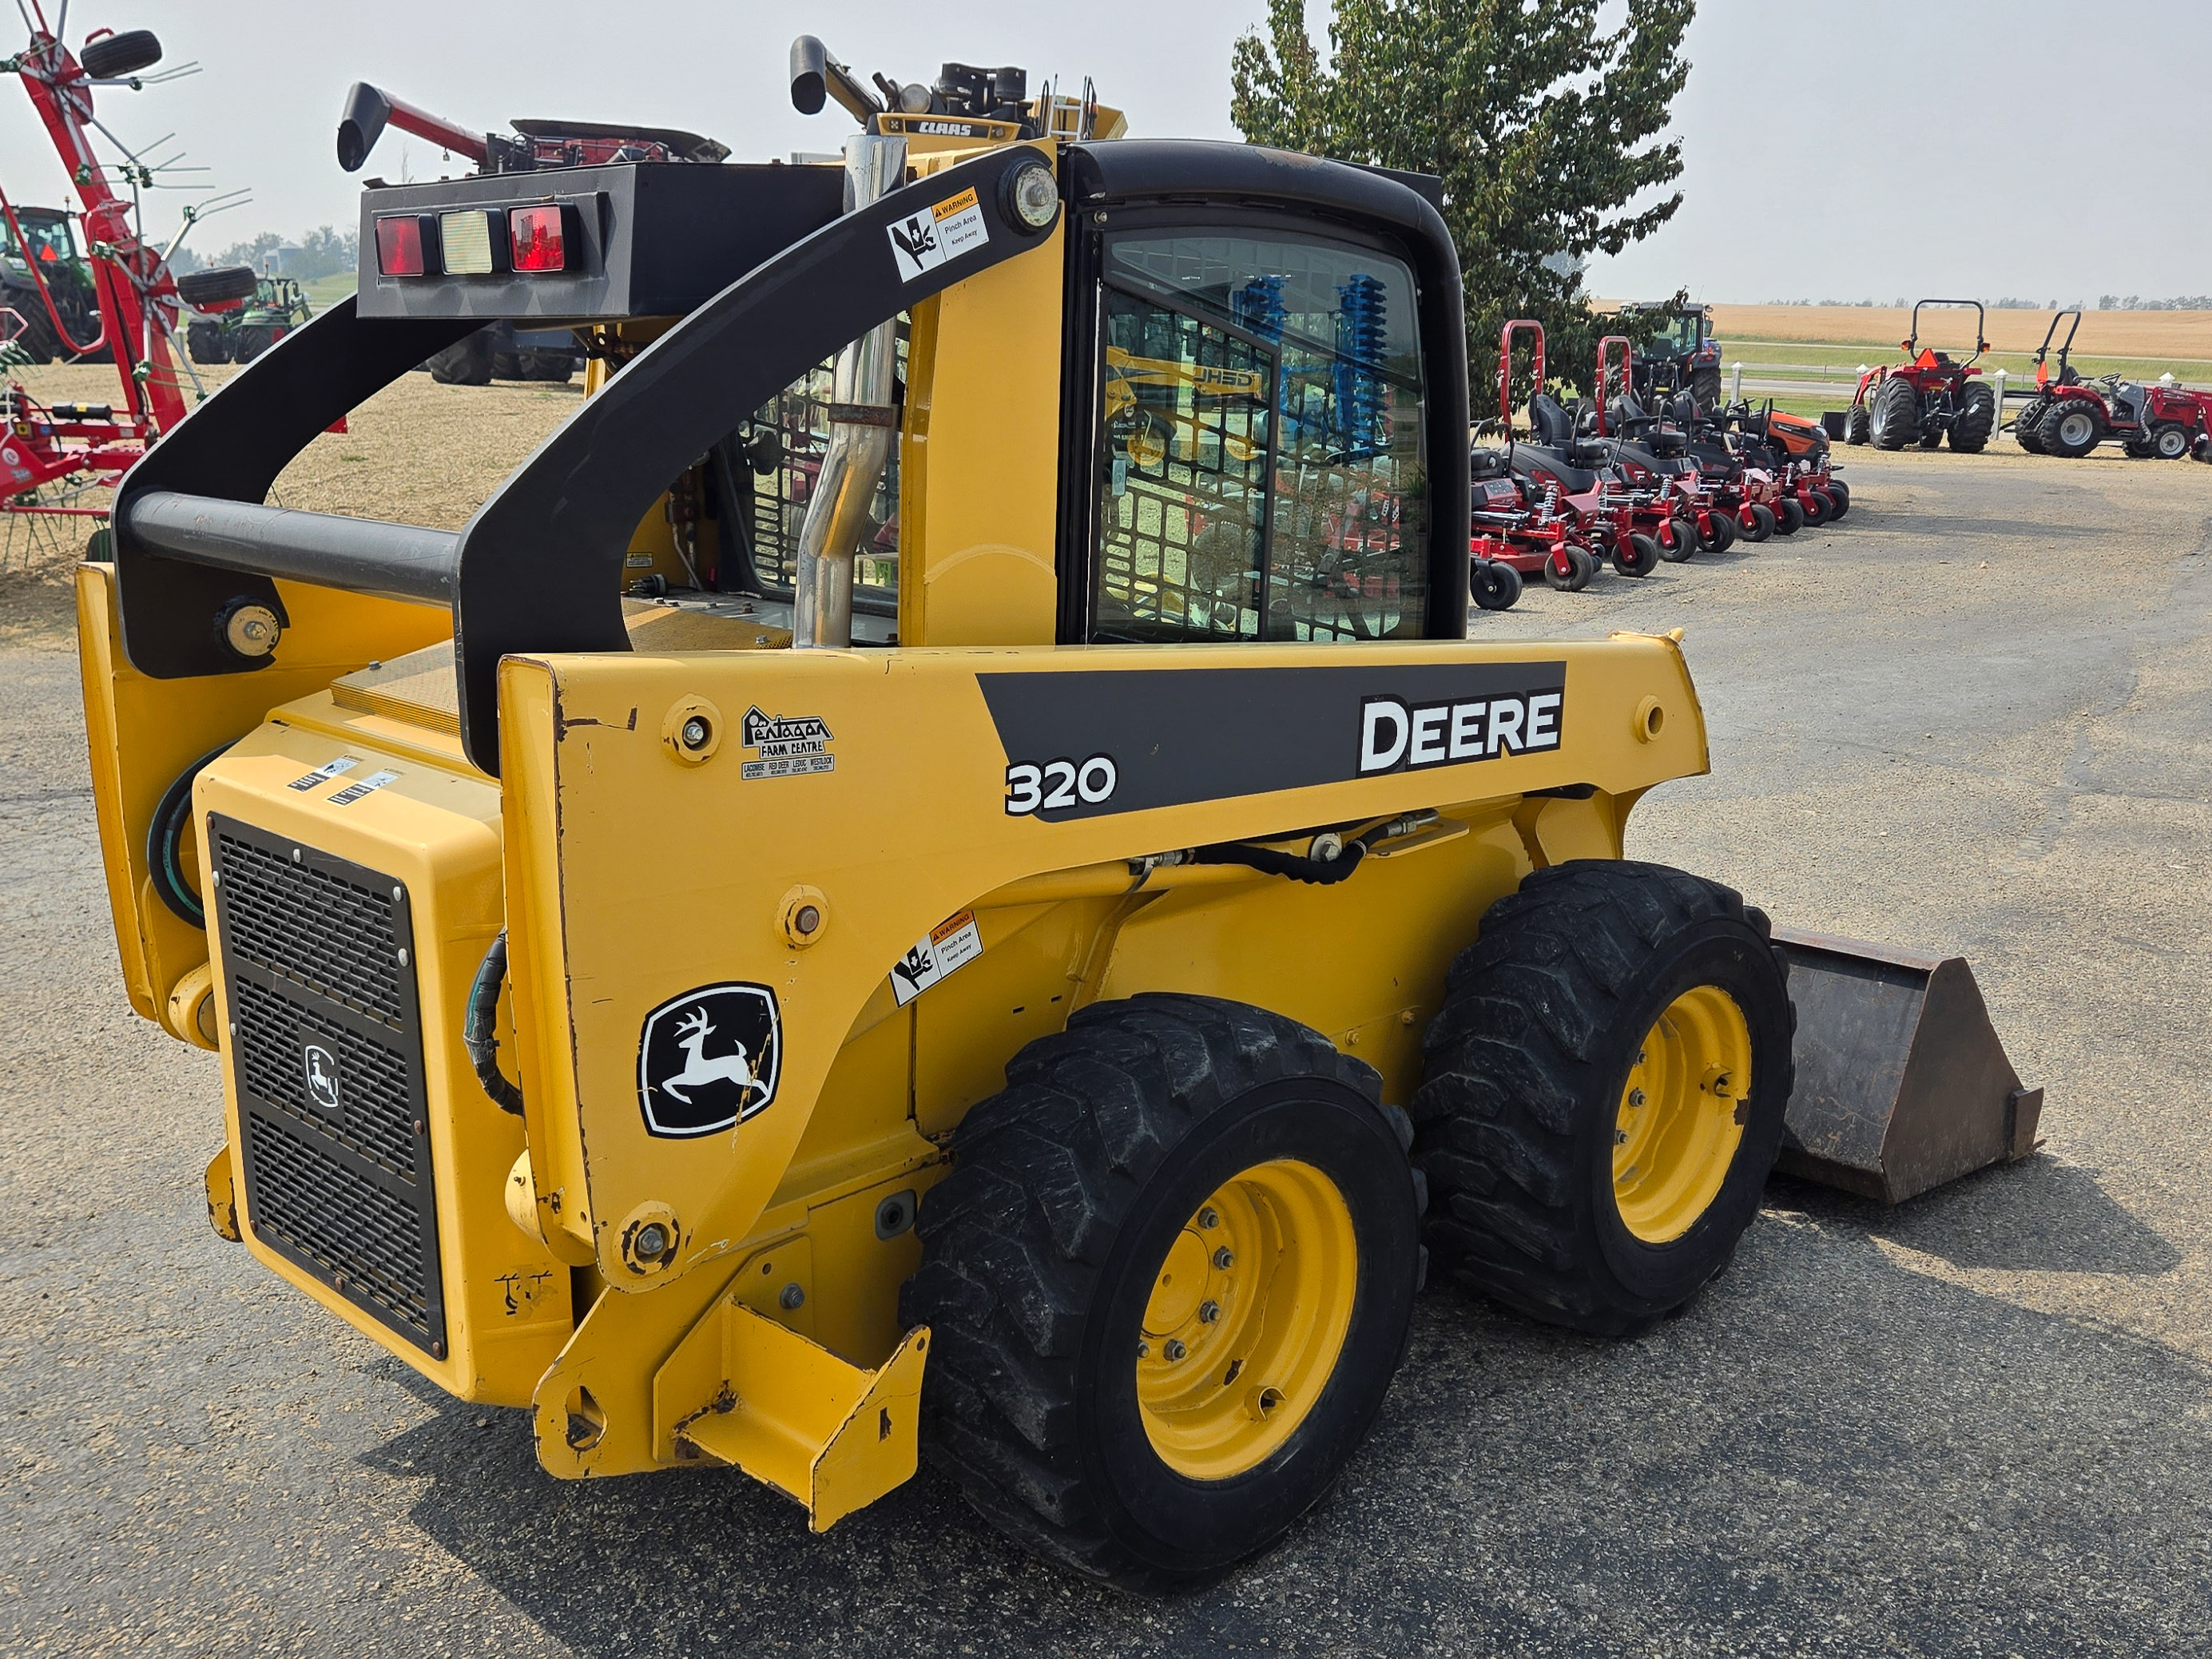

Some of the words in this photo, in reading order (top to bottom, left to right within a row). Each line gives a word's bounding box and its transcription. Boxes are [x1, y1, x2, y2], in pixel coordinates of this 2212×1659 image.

[919, 121, 971, 137] CLAAS
[942, 194, 974, 213] WARNING
[944, 220, 963, 235] Pinch
[963, 214, 977, 226] Area
[951, 236, 963, 245] Keep
[964, 229, 978, 239] Away
[745, 708, 831, 745] Pentagon
[1360, 693, 1561, 772] DEERE
[761, 744, 788, 757] FARM
[791, 740, 823, 754] CENTRE
[792, 759, 807, 768] LEDUC
[1007, 757, 1117, 813] 320
[939, 914, 970, 936] WARNING
[941, 941, 958, 955] Pinch
[959, 931, 972, 943] Area
[947, 954, 959, 962] Keep
[959, 945, 972, 955] Away
